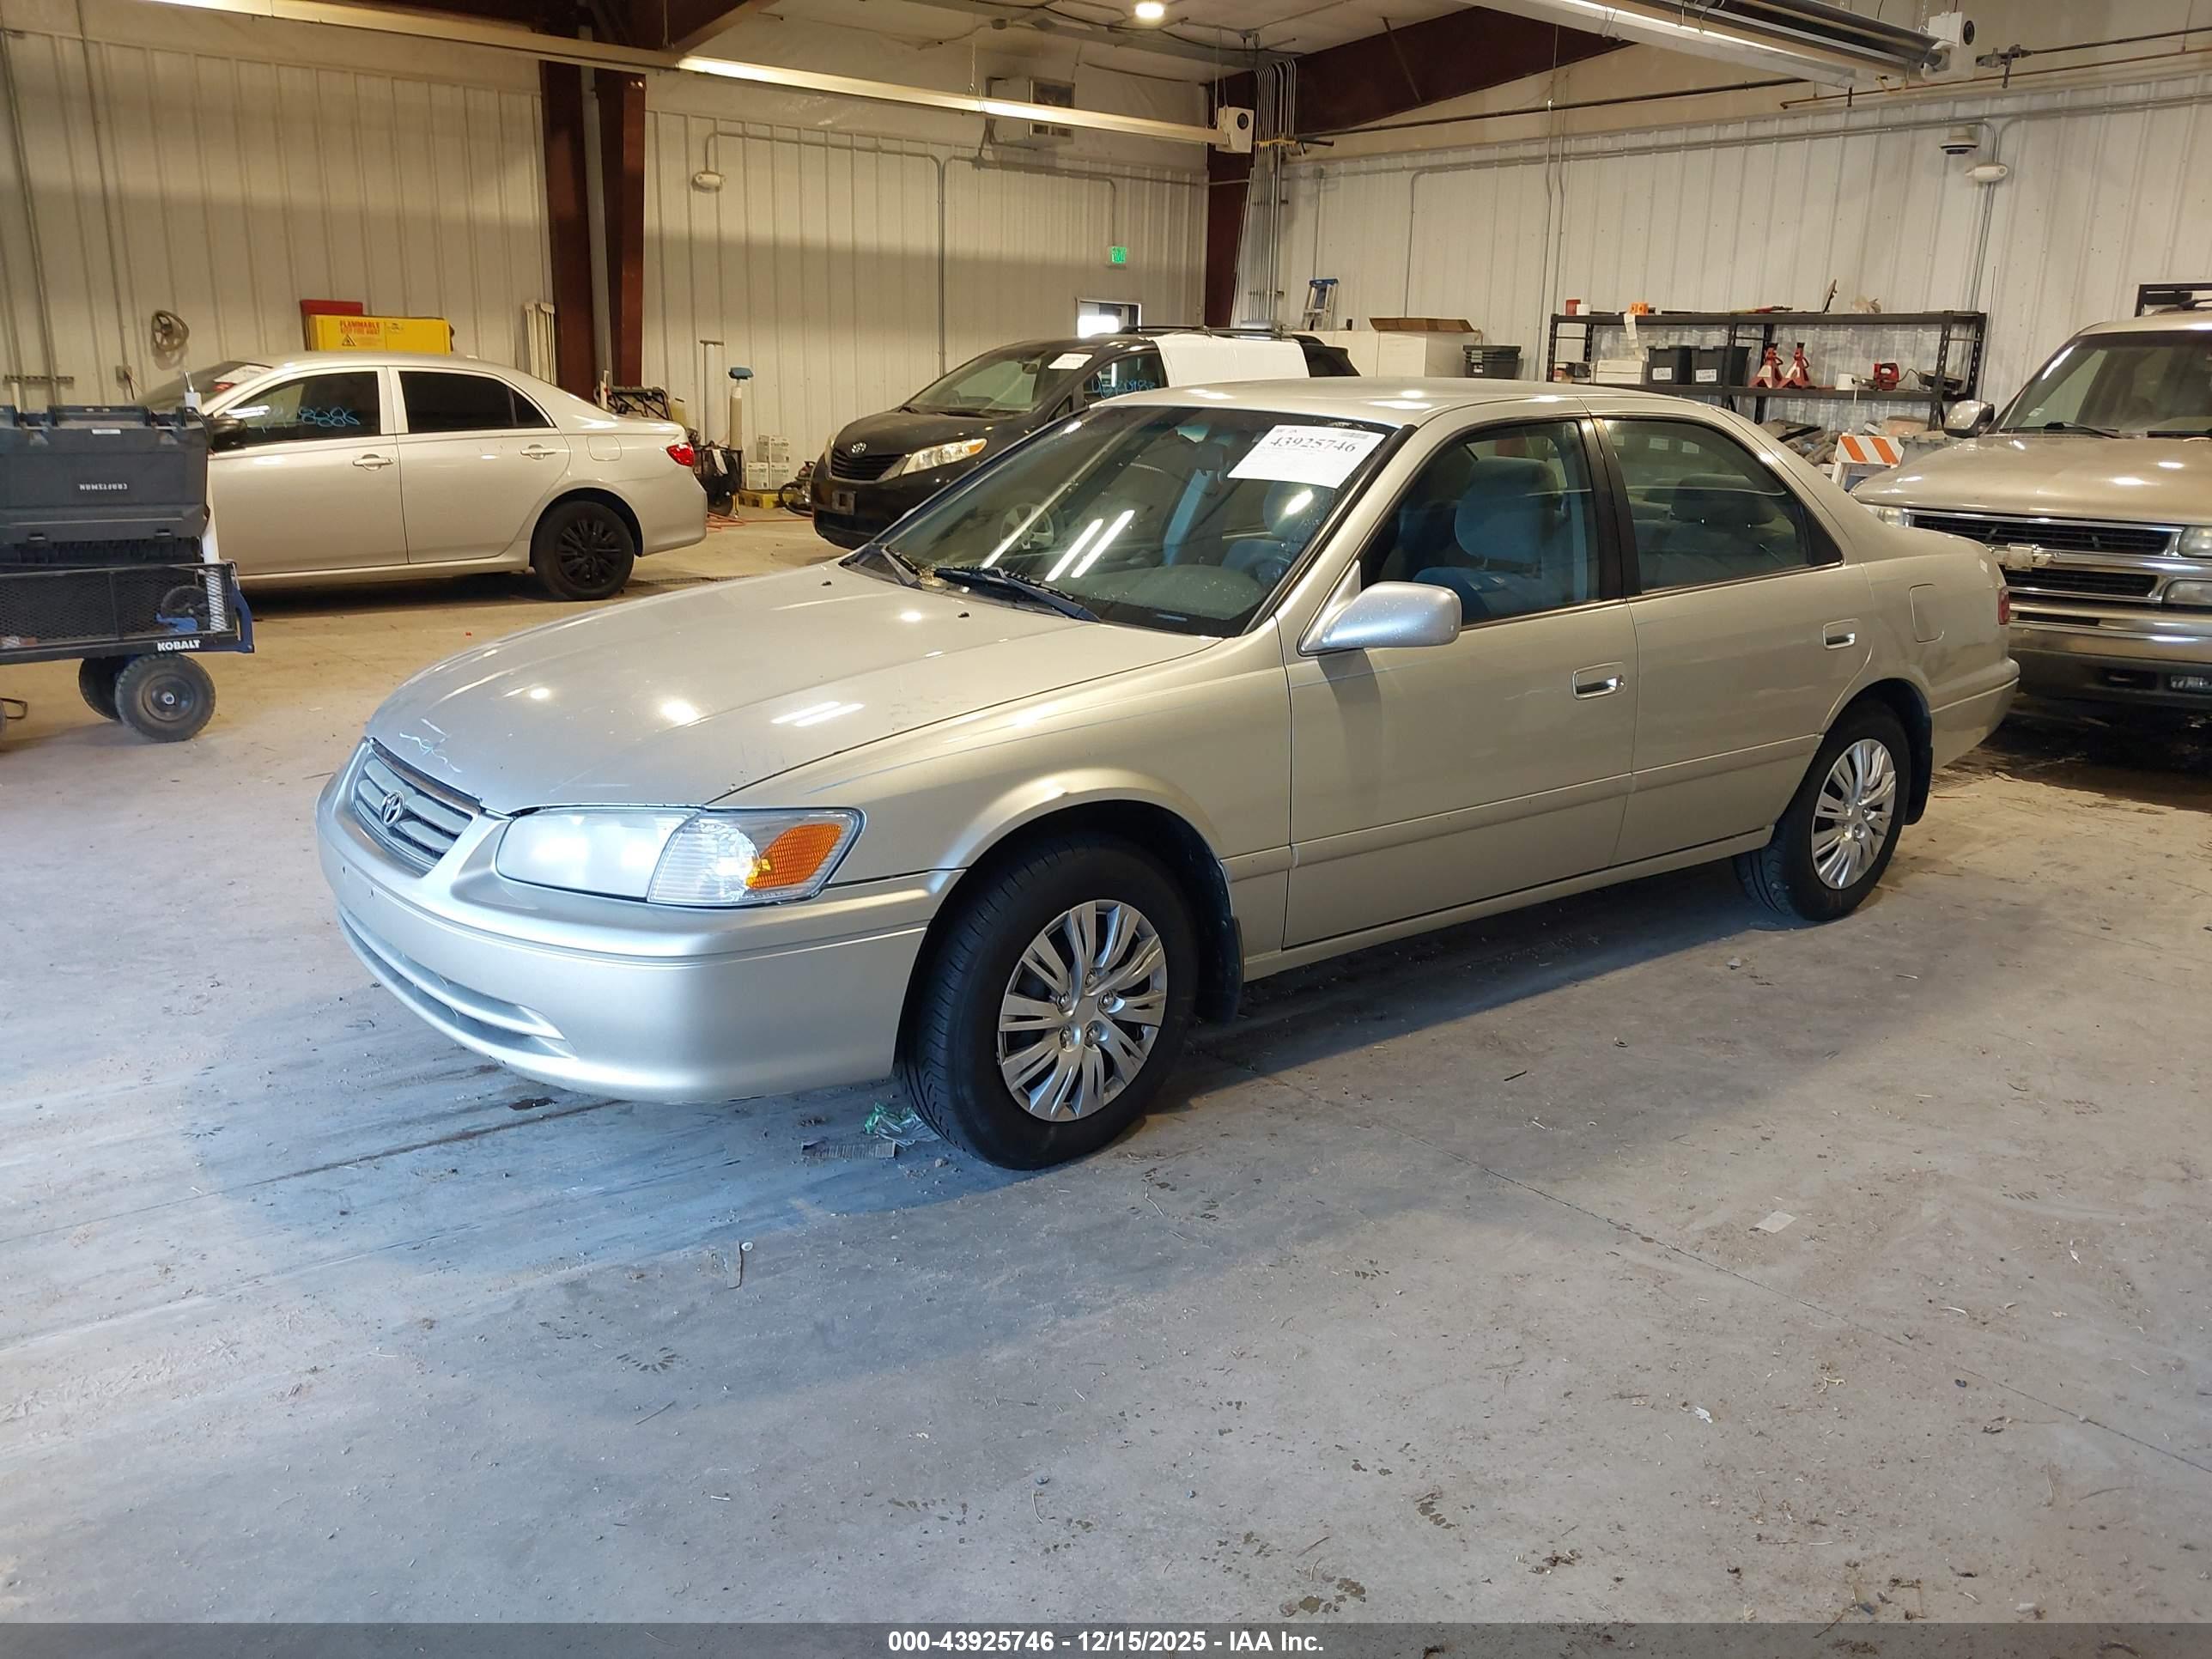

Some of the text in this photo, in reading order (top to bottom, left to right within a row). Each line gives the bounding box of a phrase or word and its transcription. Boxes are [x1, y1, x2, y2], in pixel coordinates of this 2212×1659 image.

[1270, 435, 1356, 453] 43925746
[79, 483, 128, 491] CRAFTSMAN
[157, 639, 201, 652] KOBALT
